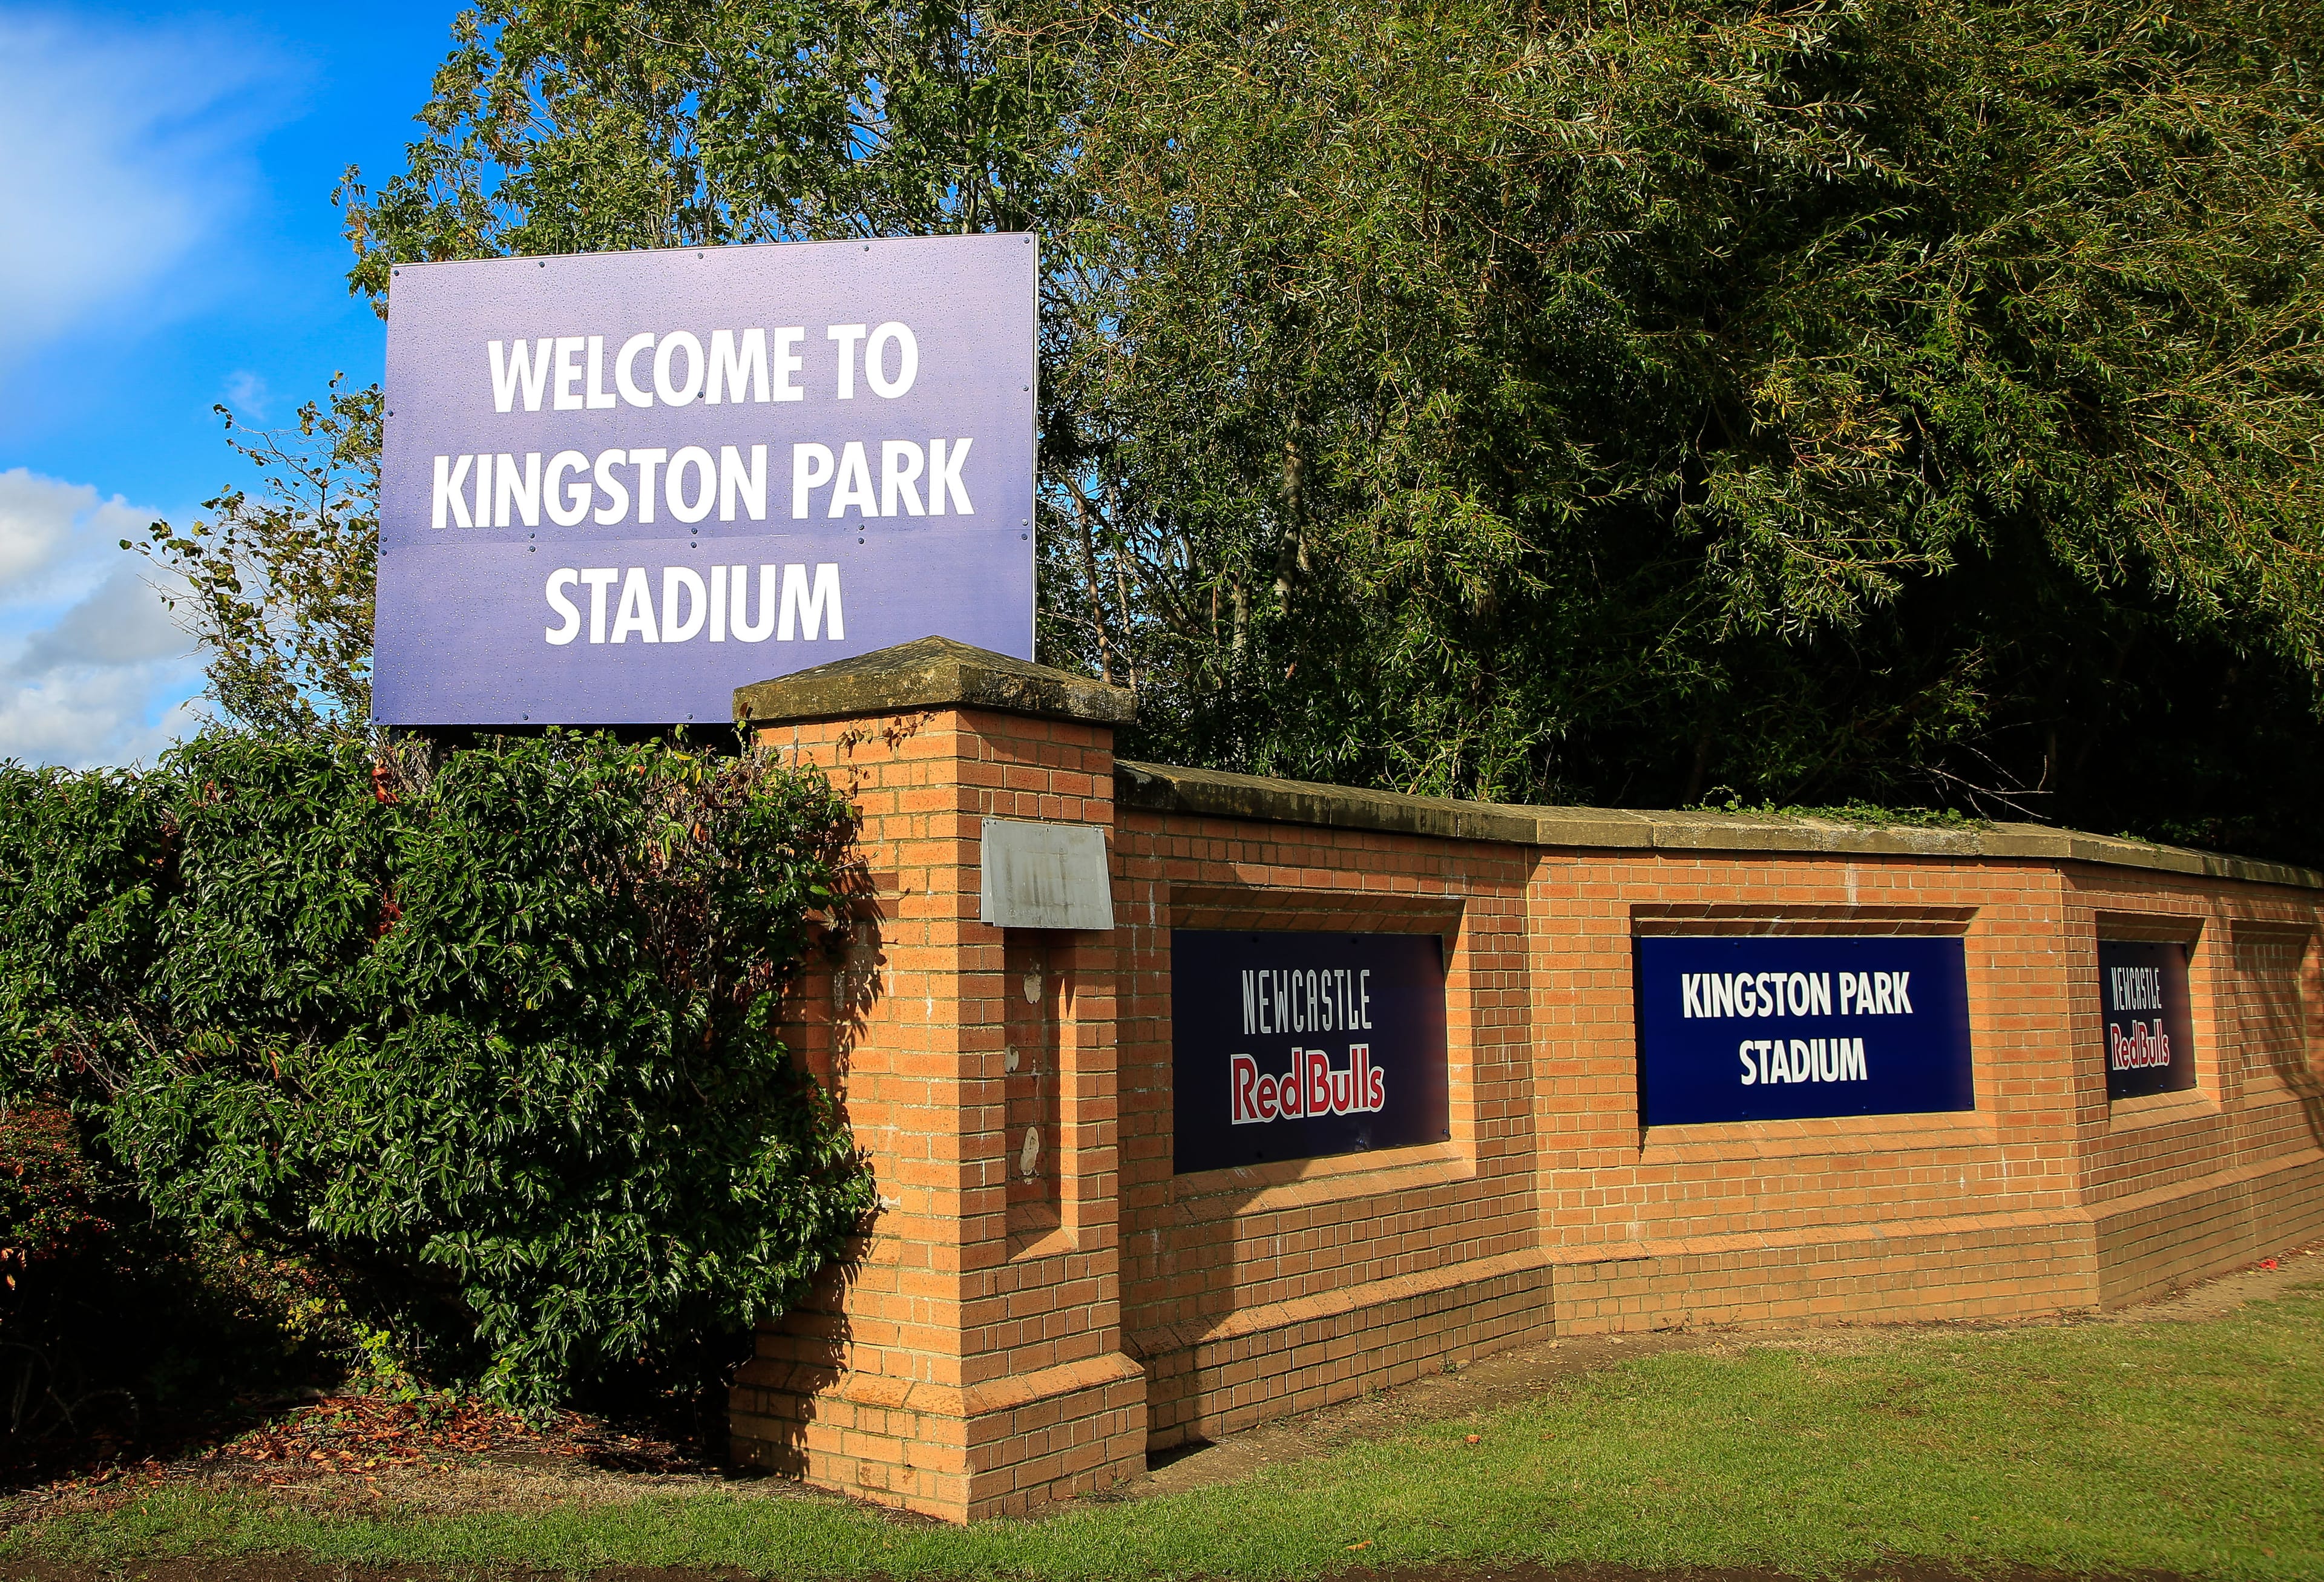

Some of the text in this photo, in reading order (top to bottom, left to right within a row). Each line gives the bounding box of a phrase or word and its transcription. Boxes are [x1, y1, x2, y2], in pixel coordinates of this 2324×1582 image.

[488, 321, 918, 413] WELCOME TO
[432, 438, 975, 529] KINGSTON PARK
[545, 563, 845, 646] STADIUM
[1242, 969, 1372, 1035] NEWCASTLE
[1682, 971, 1913, 1018] KINGSTON PARK
[2110, 967, 2162, 1011] NEWCASTLE
[1739, 1037, 1868, 1085] STADIUM
